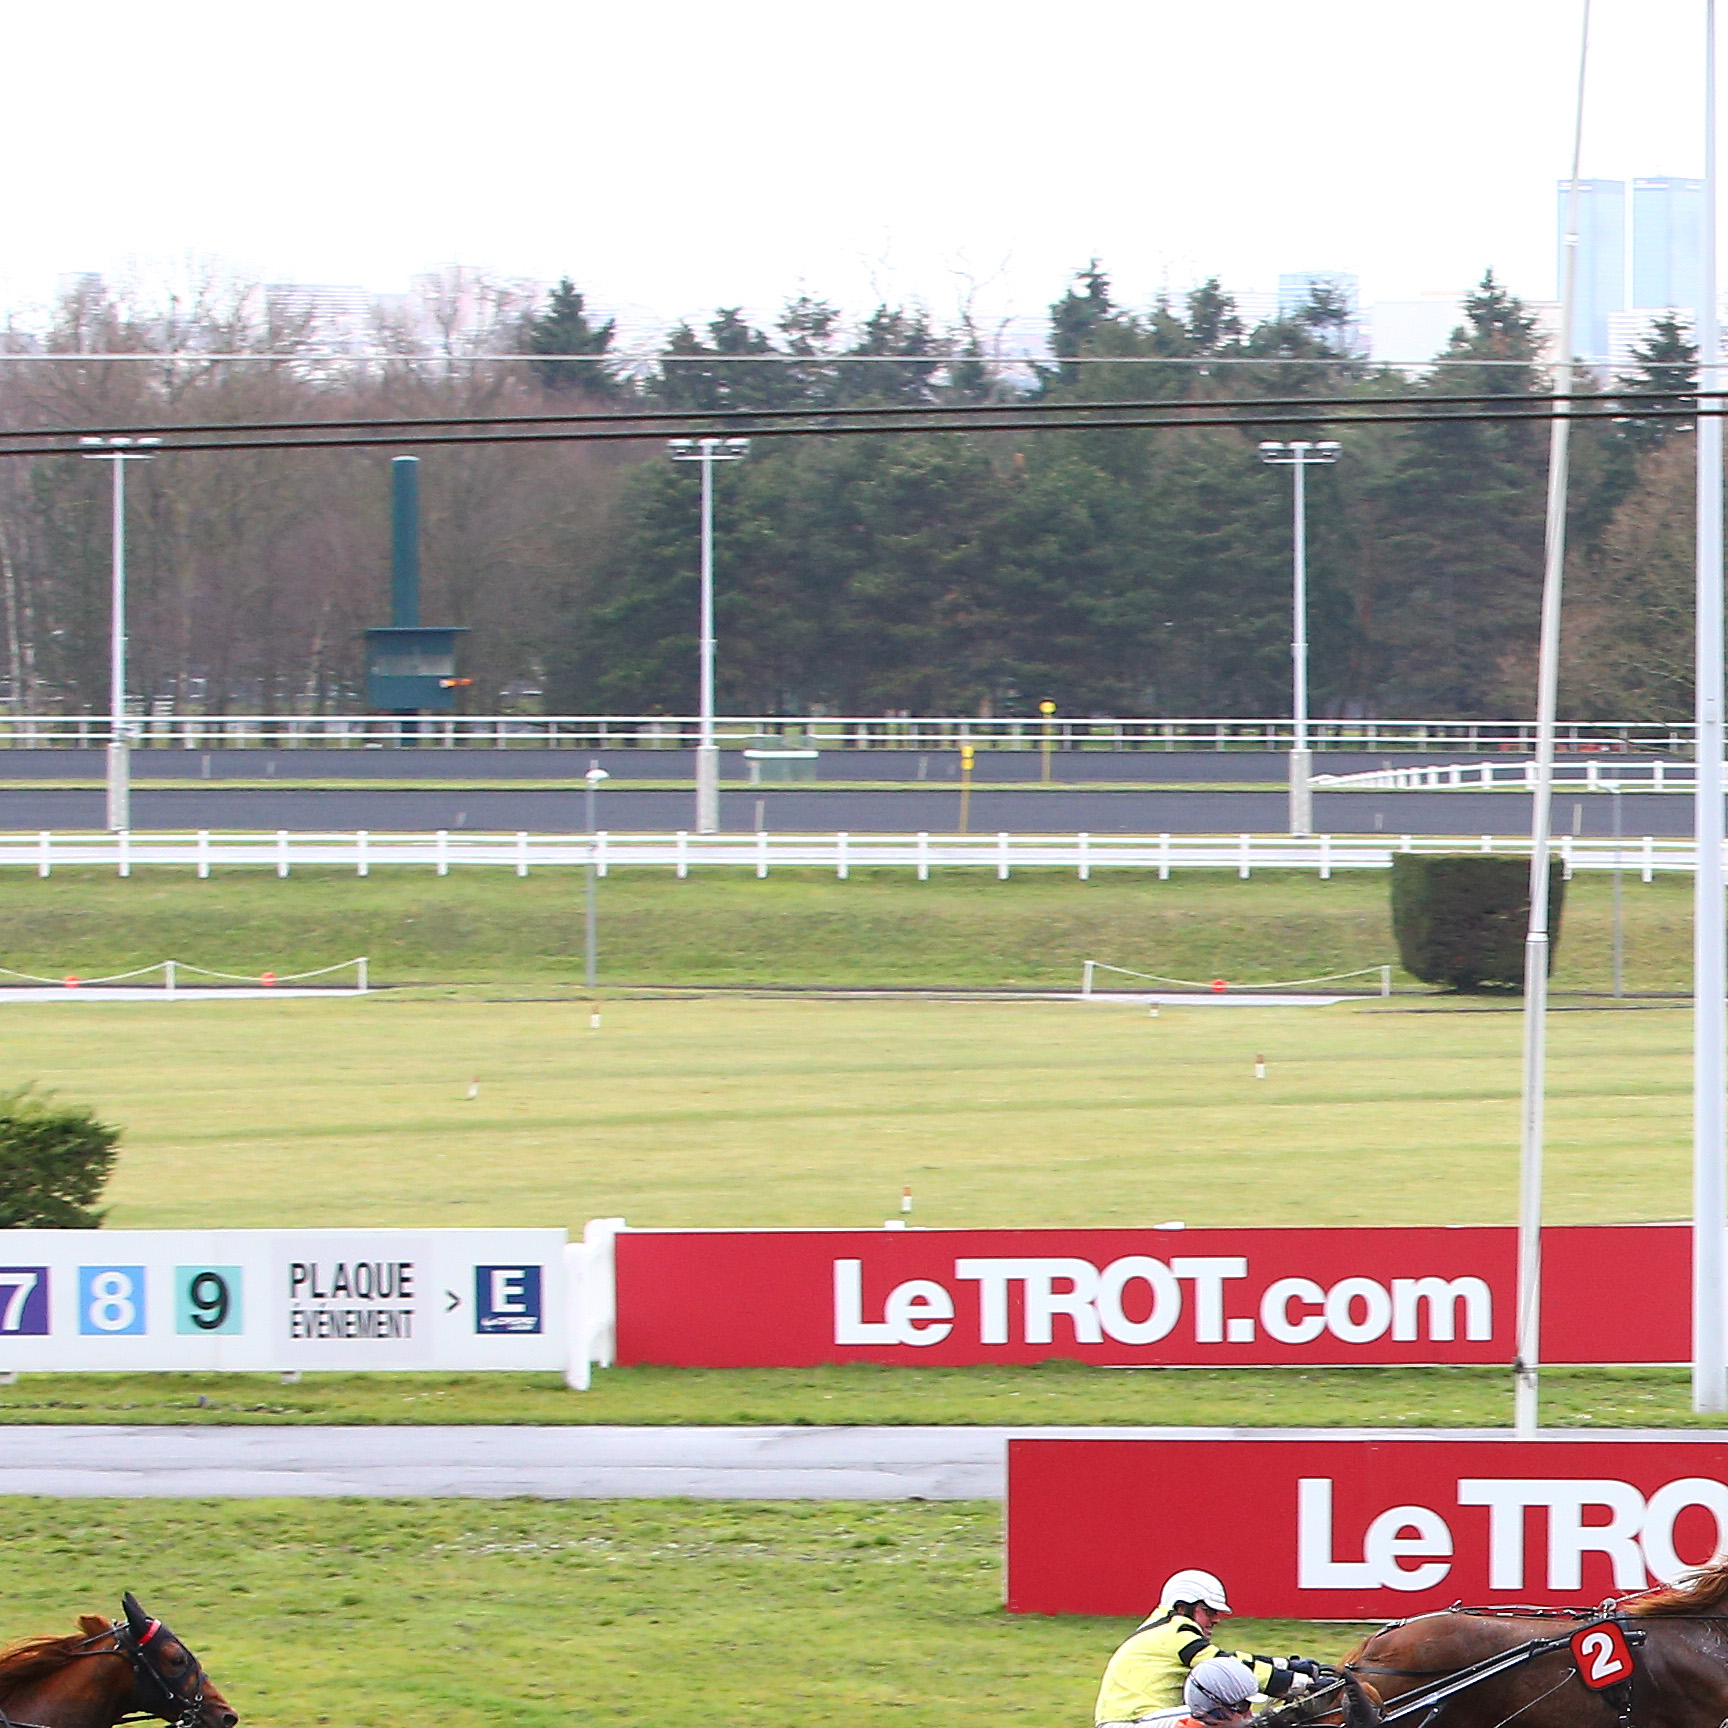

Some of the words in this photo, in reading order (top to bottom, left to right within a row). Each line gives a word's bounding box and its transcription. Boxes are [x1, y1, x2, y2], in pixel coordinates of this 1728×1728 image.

[0, 1272, 39, 1331] 7
[89, 1271, 136, 1332] 8
[189, 1271, 231, 1331] 9
[289, 1260, 414, 1300] PLAQUE
[489, 1269, 527, 1313] E
[833, 1255, 1494, 1347] LeTROT.com
[1580, 1631, 1616, 1681] 2
